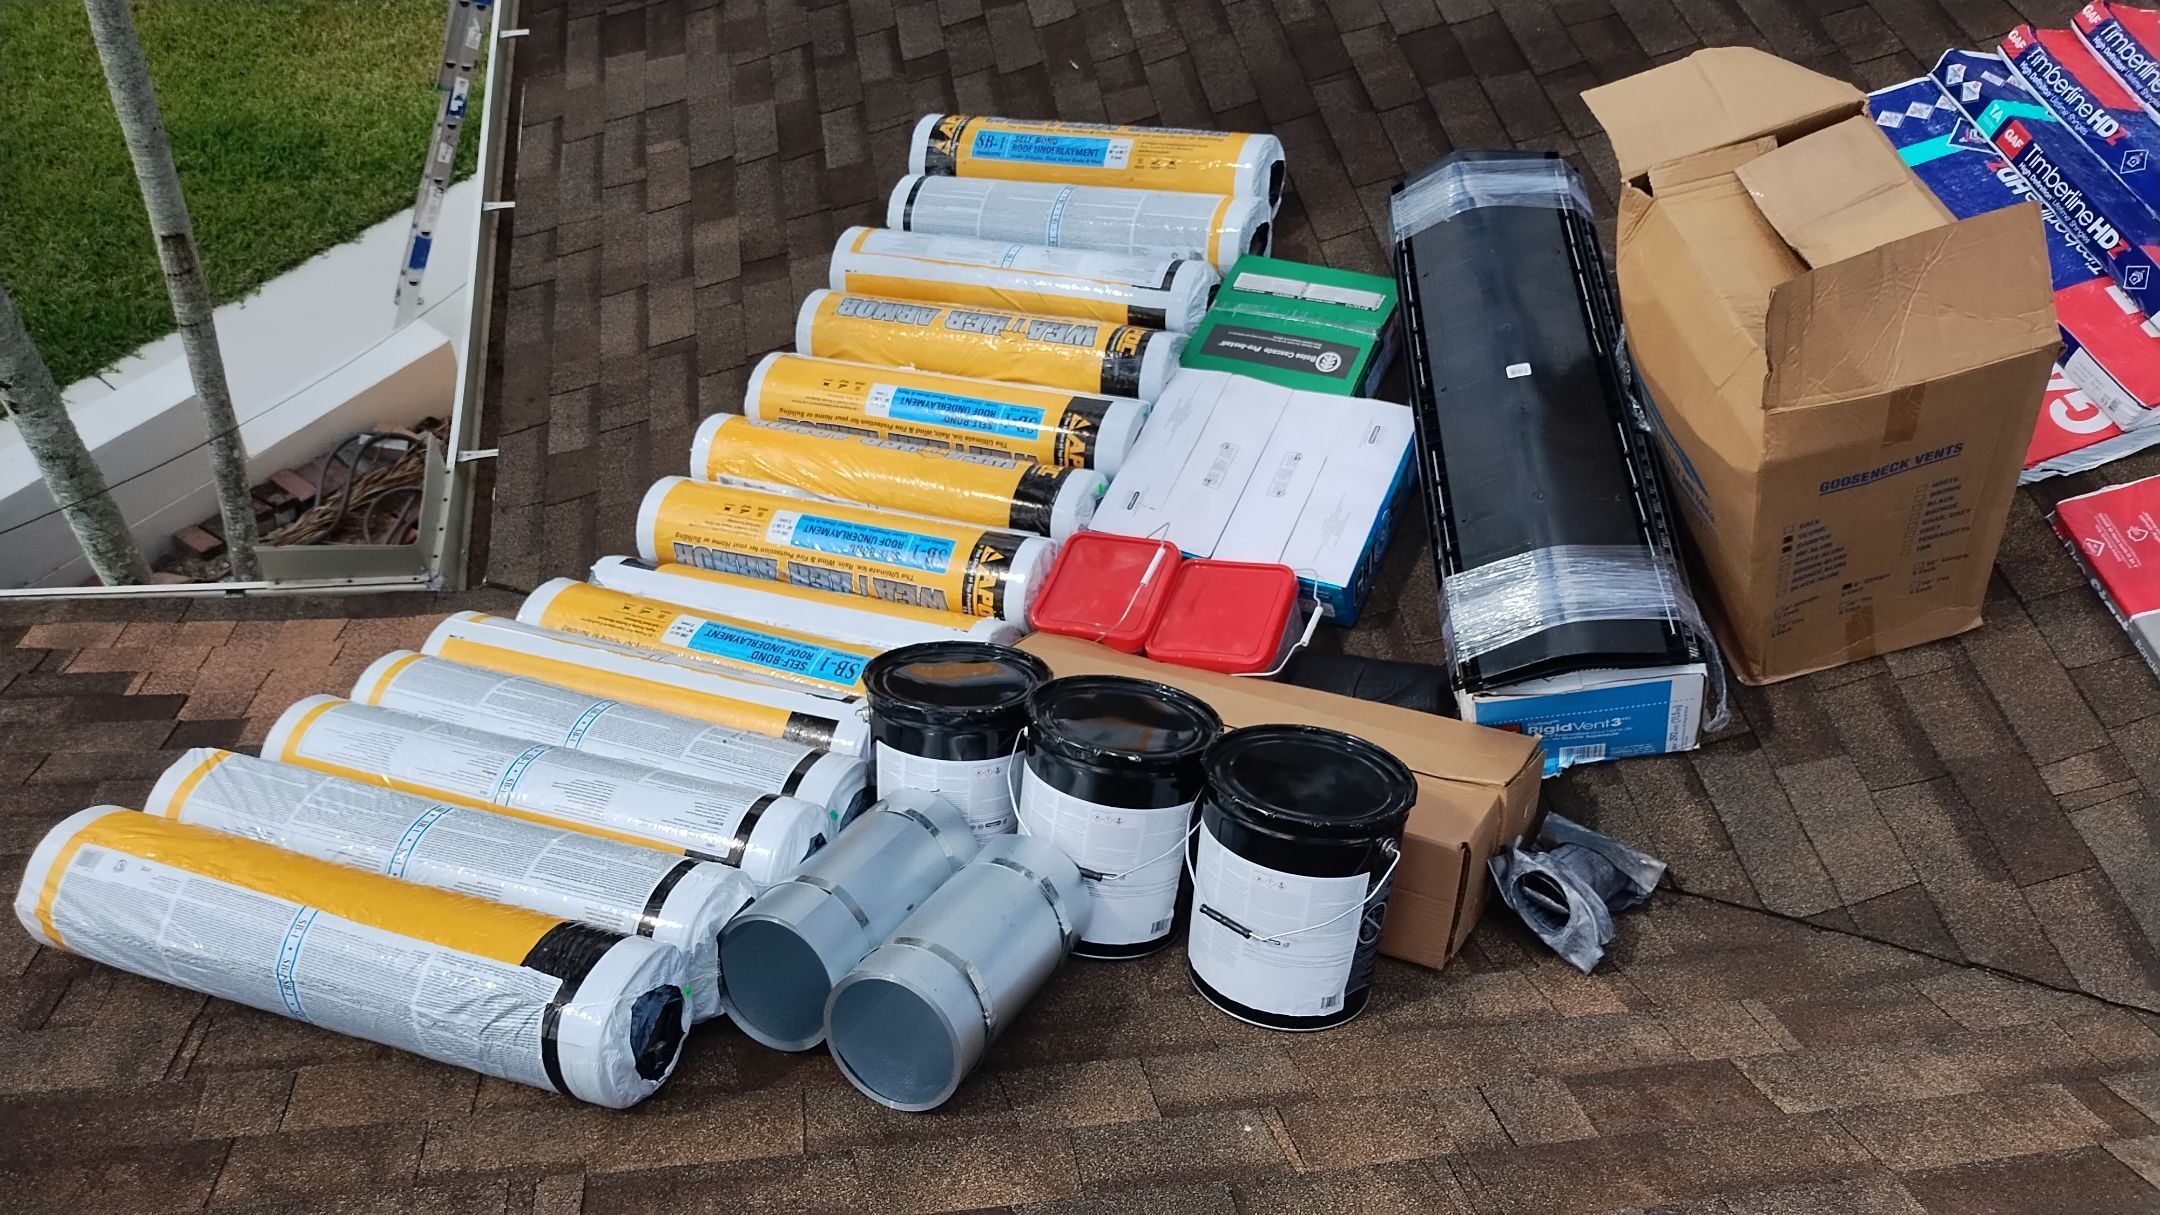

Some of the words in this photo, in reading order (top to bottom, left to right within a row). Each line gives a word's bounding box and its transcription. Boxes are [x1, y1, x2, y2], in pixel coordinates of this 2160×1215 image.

[2082, 4, 2102, 24] GAF
[2007, 29, 2027, 49] GAF
[2025, 46, 2090, 118] Timberline
[976, 134, 1005, 150] SB-1
[2003, 127, 2024, 150] GAF
[1034, 145, 1099, 157] UNDERLAYMENT
[2017, 162, 2032, 176] High
[2023, 142, 2096, 227] Timberline
[2086, 216, 2129, 260] HDZ
[837, 297, 941, 327] ARMOR
[899, 395, 960, 415] UNDERLAYMENT
[779, 407, 804, 417] Building
[814, 413, 832, 421] Home
[834, 414, 848, 422] your
[860, 419, 893, 429] Protection
[964, 436, 993, 445] Ultimate
[995, 440, 1007, 448] The
[1820, 459, 1910, 493] GOOSENECK
[1915, 442, 1964, 465] VENTS
[675, 531, 701, 542] Building
[803, 523, 876, 546] UNDERLAYMENT
[877, 533, 906, 549] ROOF
[711, 538, 730, 546] Home
[760, 547, 794, 558] Protection
[795, 553, 808, 561] Fire
[817, 557, 835, 565] Wind
[868, 566, 899, 578] Ultimate
[900, 573, 914, 581] The
[704, 628, 785, 653] UNDERLAYMENT
[750, 650, 807, 670] SELF-BOND
[786, 648, 814, 659] ROOF
[819, 656, 860, 679] SB-1
